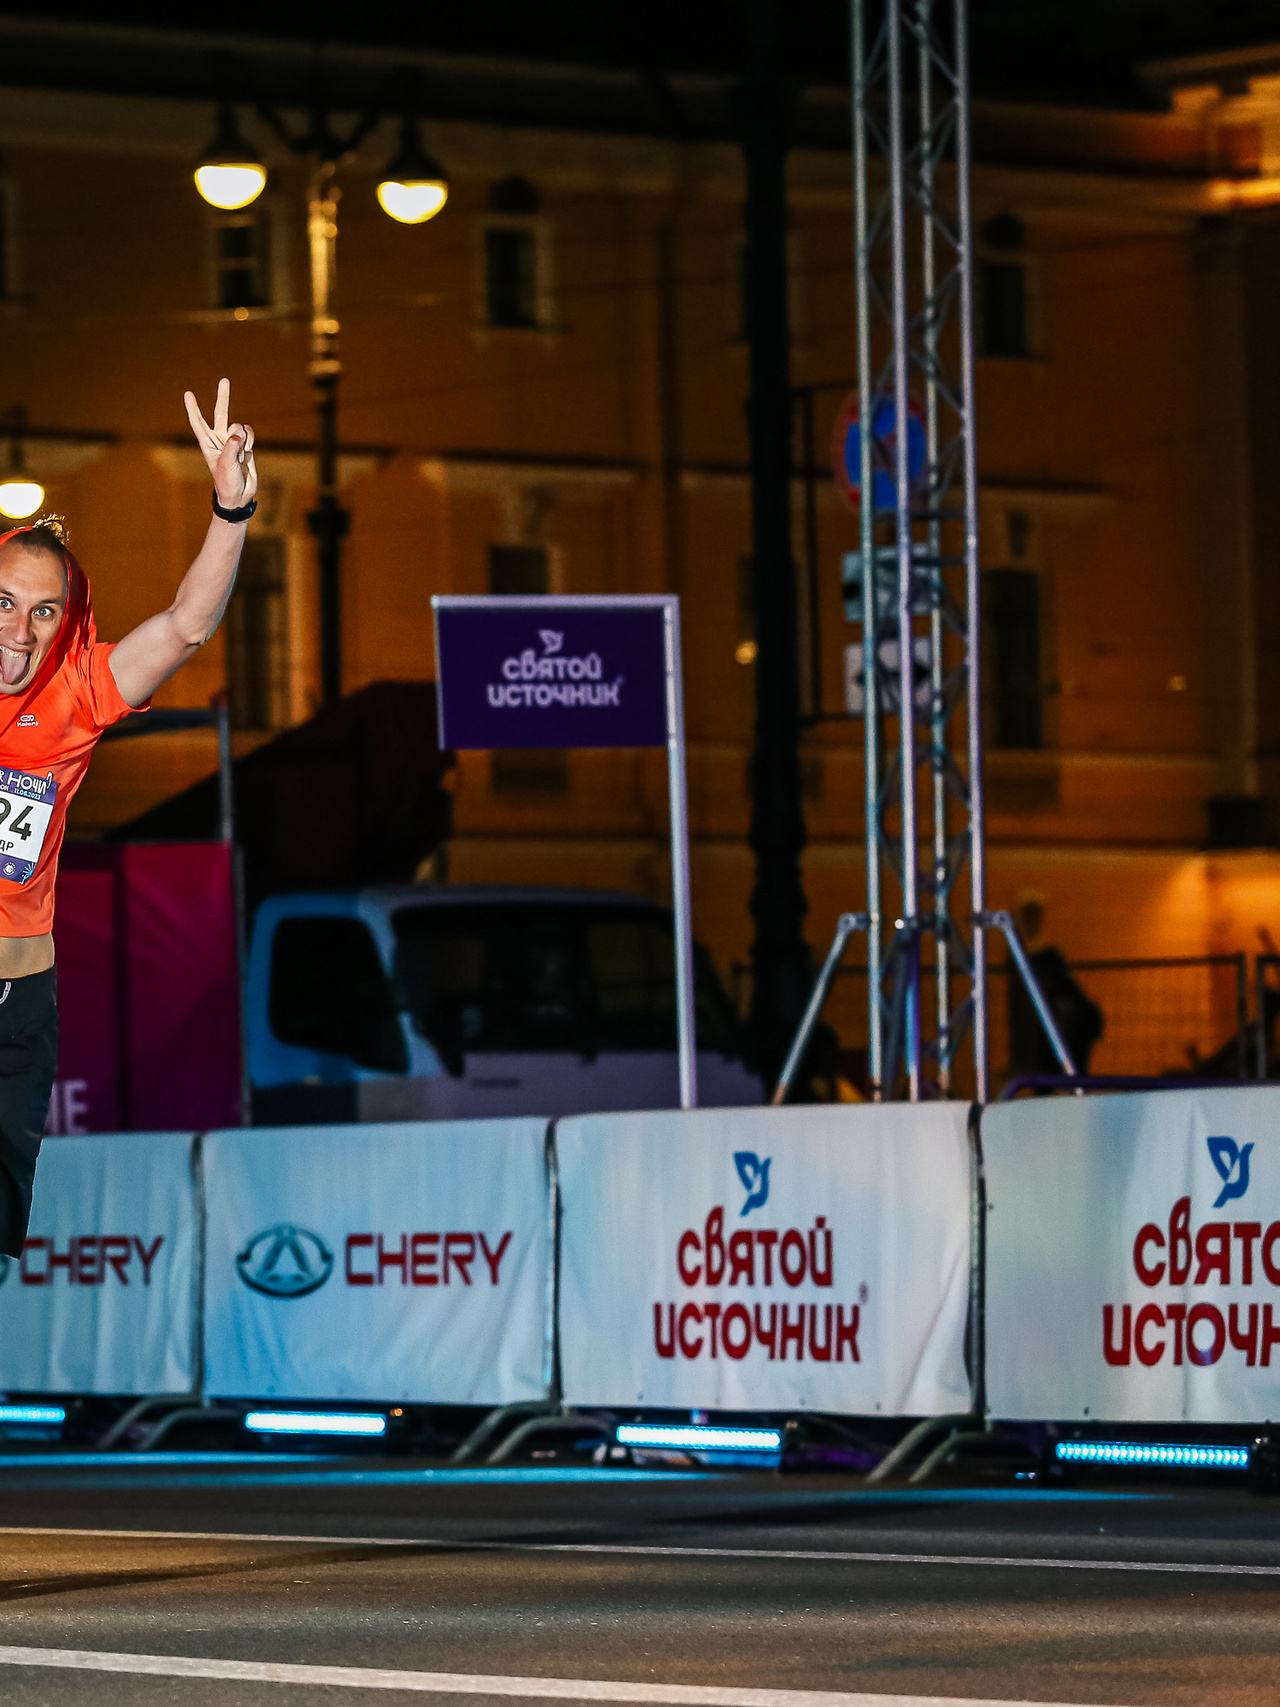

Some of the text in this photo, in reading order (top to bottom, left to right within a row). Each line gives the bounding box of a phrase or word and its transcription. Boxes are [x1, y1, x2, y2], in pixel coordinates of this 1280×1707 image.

[7, 772, 47, 795] НОЧИ
[21, 1234, 164, 1287] CHERY
[345, 1231, 513, 1287] CHERY
